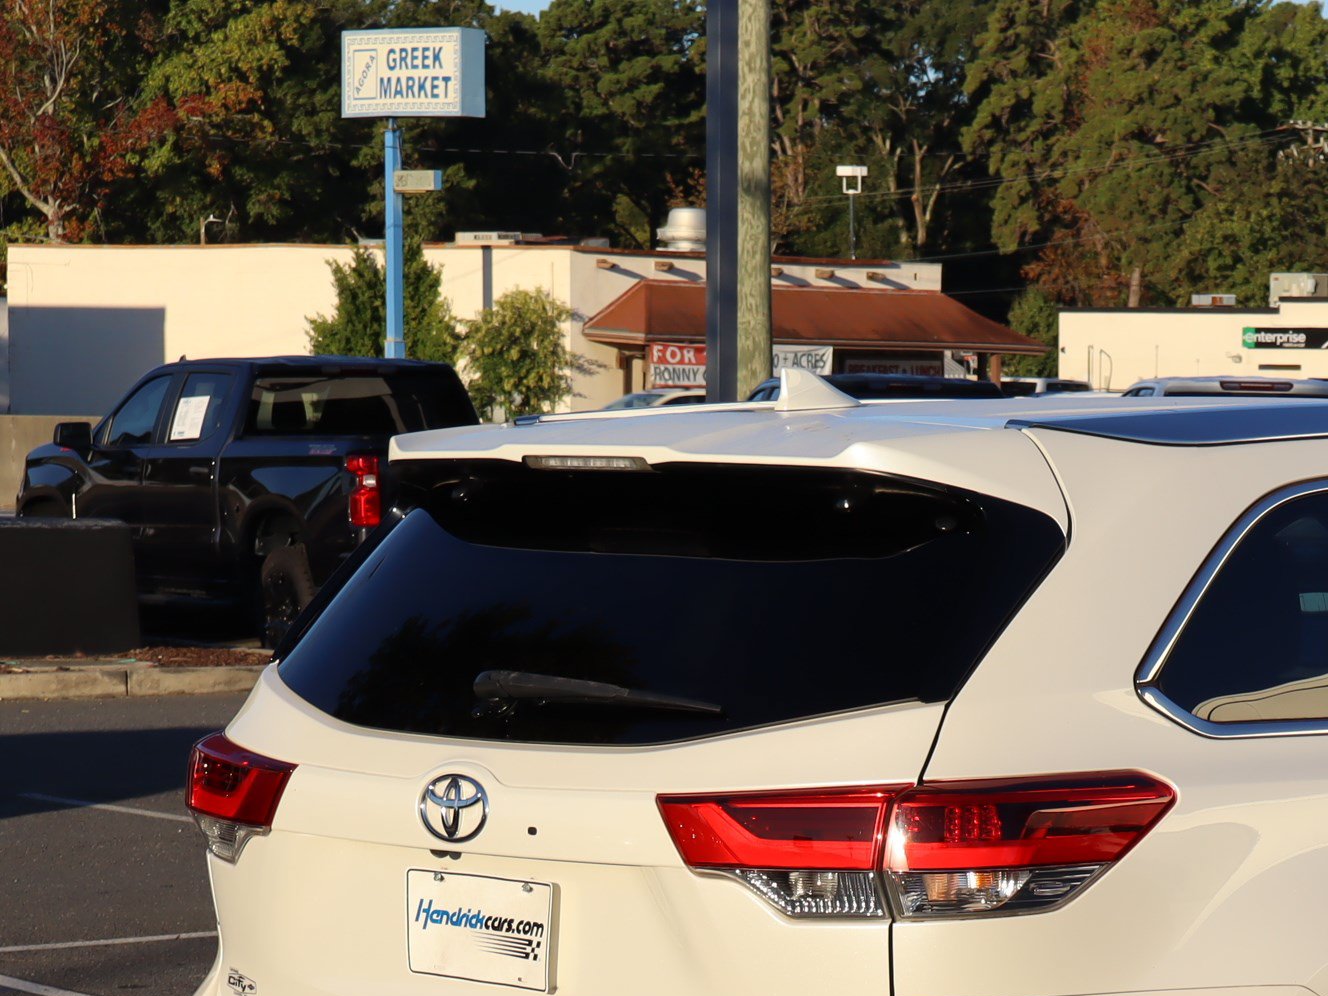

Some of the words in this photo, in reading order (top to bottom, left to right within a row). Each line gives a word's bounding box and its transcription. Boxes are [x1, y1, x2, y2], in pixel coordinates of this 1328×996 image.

[386, 46, 443, 71] GREEK
[354, 54, 375, 95] AGORA
[379, 76, 452, 99] MARKET
[1243, 330, 1307, 346] enterprise
[653, 345, 696, 364] FOR
[791, 352, 826, 370] ACRES
[654, 366, 700, 383] RONNY
[415, 899, 544, 938] Hendrickcars.com
